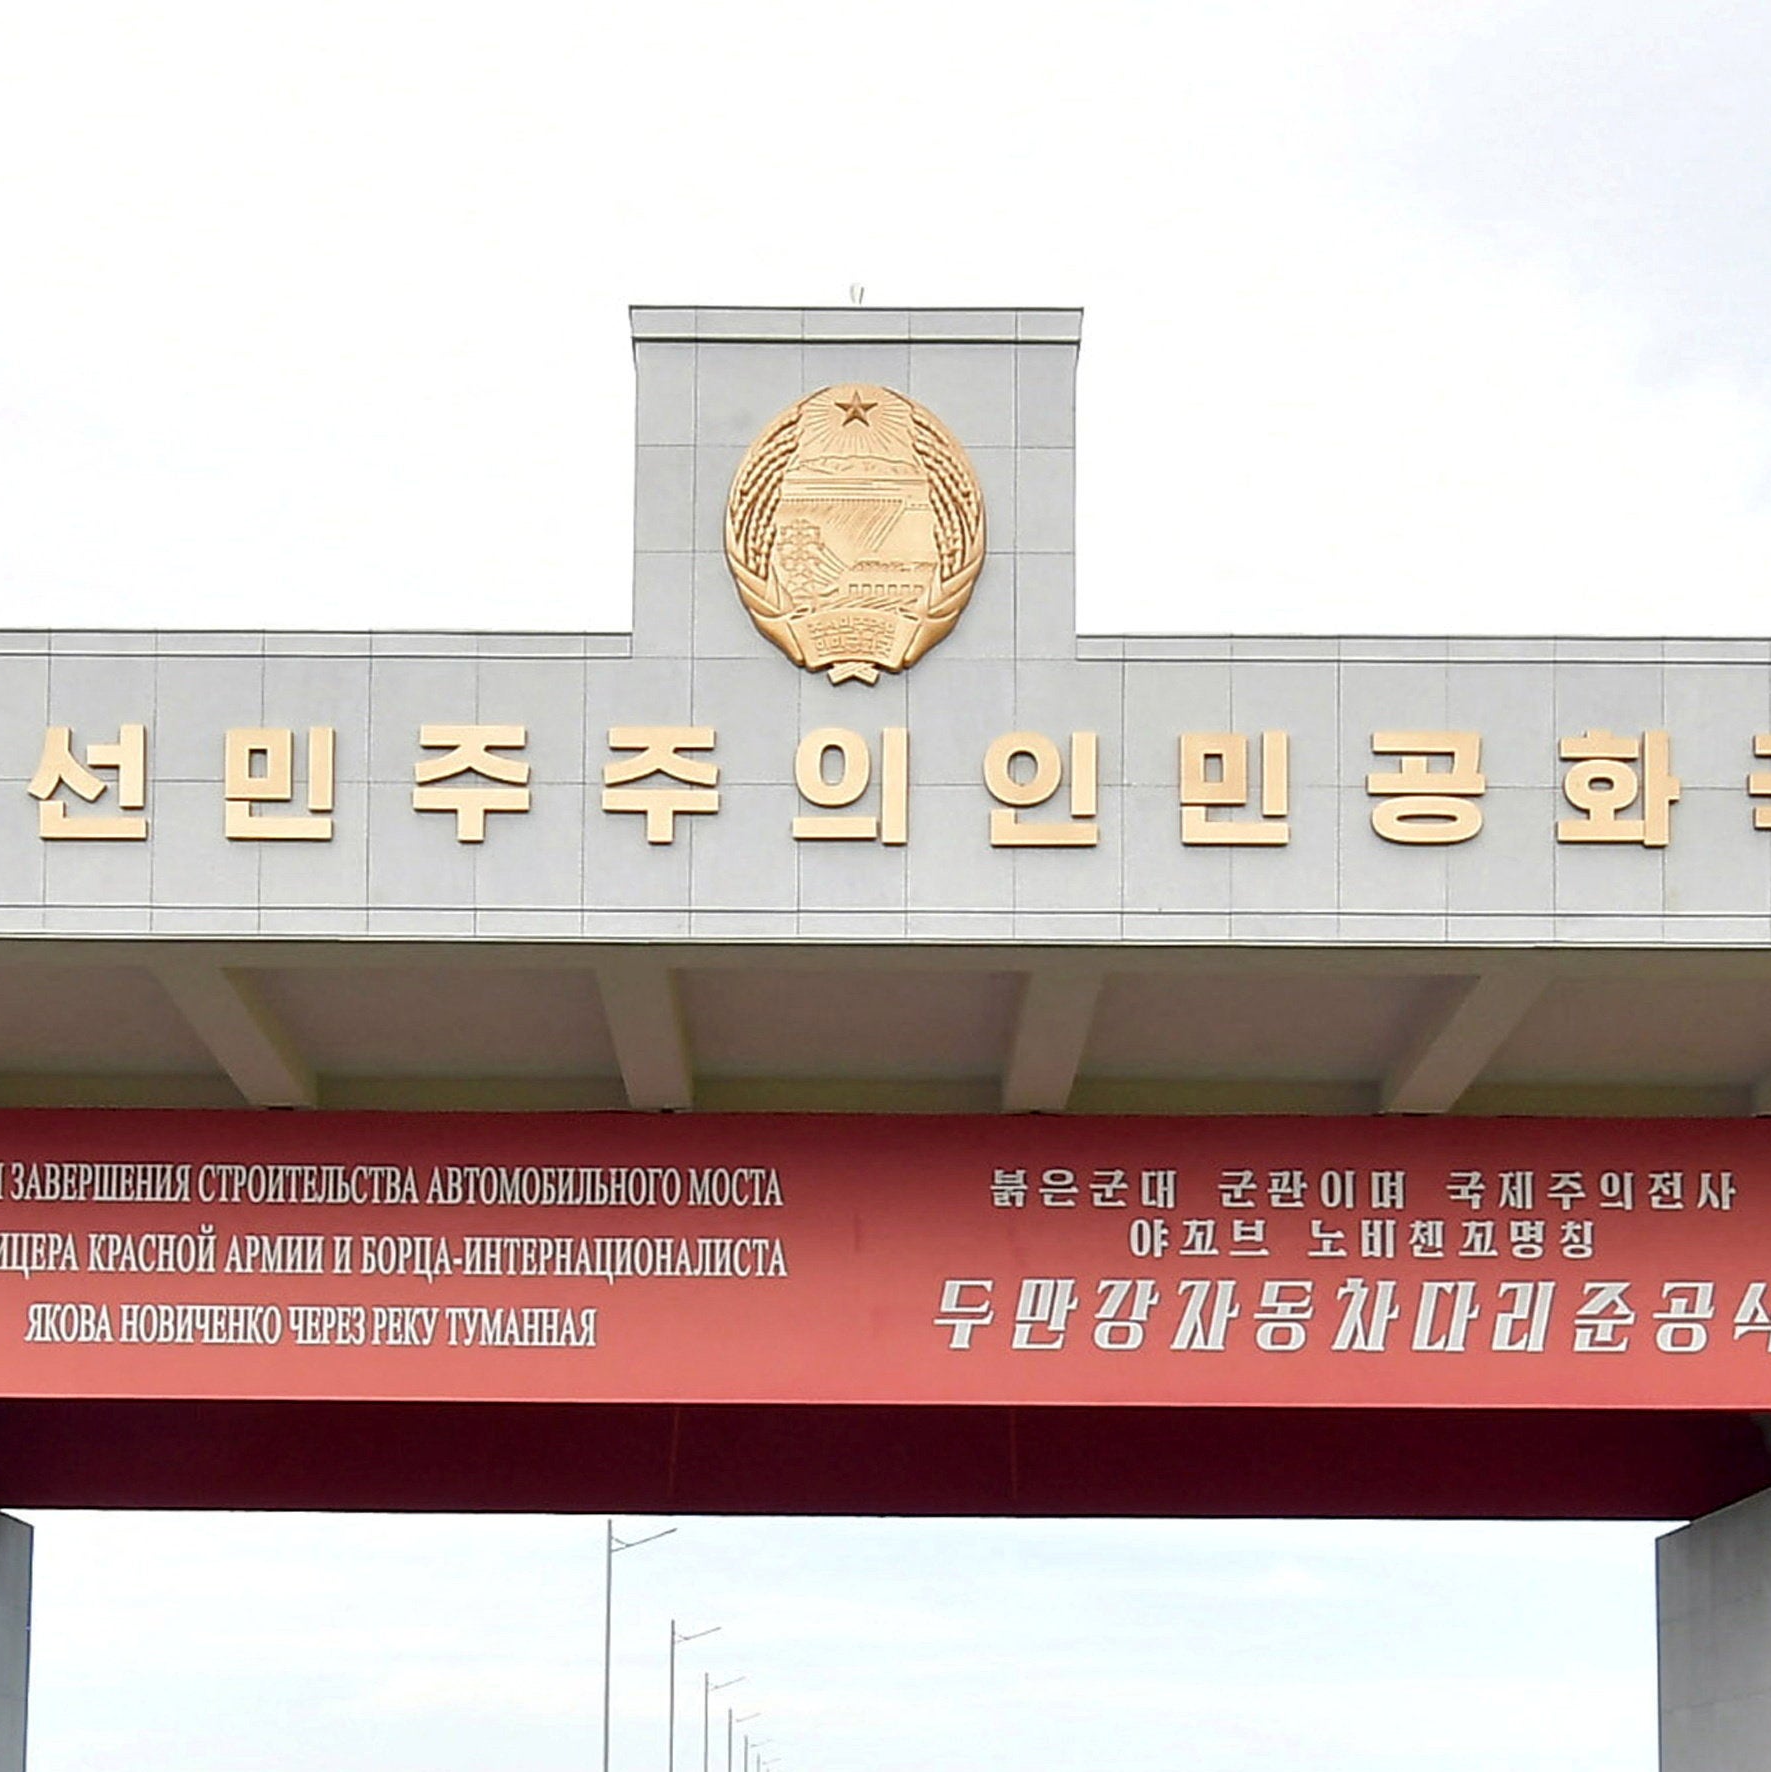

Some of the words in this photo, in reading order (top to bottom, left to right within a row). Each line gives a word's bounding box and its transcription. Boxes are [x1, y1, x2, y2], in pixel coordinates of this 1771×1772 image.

[10, 1162, 191, 1204] ЗАВЕРШЕНИЯ
[198, 1164, 419, 1205] СТРОИТЕЛЬСТВА
[426, 1166, 682, 1207] АВТОМОБИЛЬНОГО
[687, 1167, 784, 1207] МОСТА
[990, 1168, 1176, 1210] 붉은군대
[1218, 1169, 1406, 1210] 군관이며
[1445, 1170, 1737, 1211] 국제주의전사
[87, 1223, 217, 1274] КРАСНОЙ
[223, 1234, 325, 1275] АРМИИ
[331, 1236, 353, 1275] И
[359, 1235, 789, 1286] БОРЦА-ИНТЕРНАЦИОНАЛИСТА
[1129, 1218, 1270, 1258] 야꼬브
[1307, 1218, 1595, 1260] 노비첸꼬명칭
[24, 1303, 114, 1344] ЯКОВА
[119, 1304, 282, 1345] НОВИЧЕНКО
[287, 1306, 366, 1346] ЧЕРЕЗ
[371, 1308, 441, 1347] РЕКУ
[445, 1308, 598, 1349] ТУМАННАЯ
